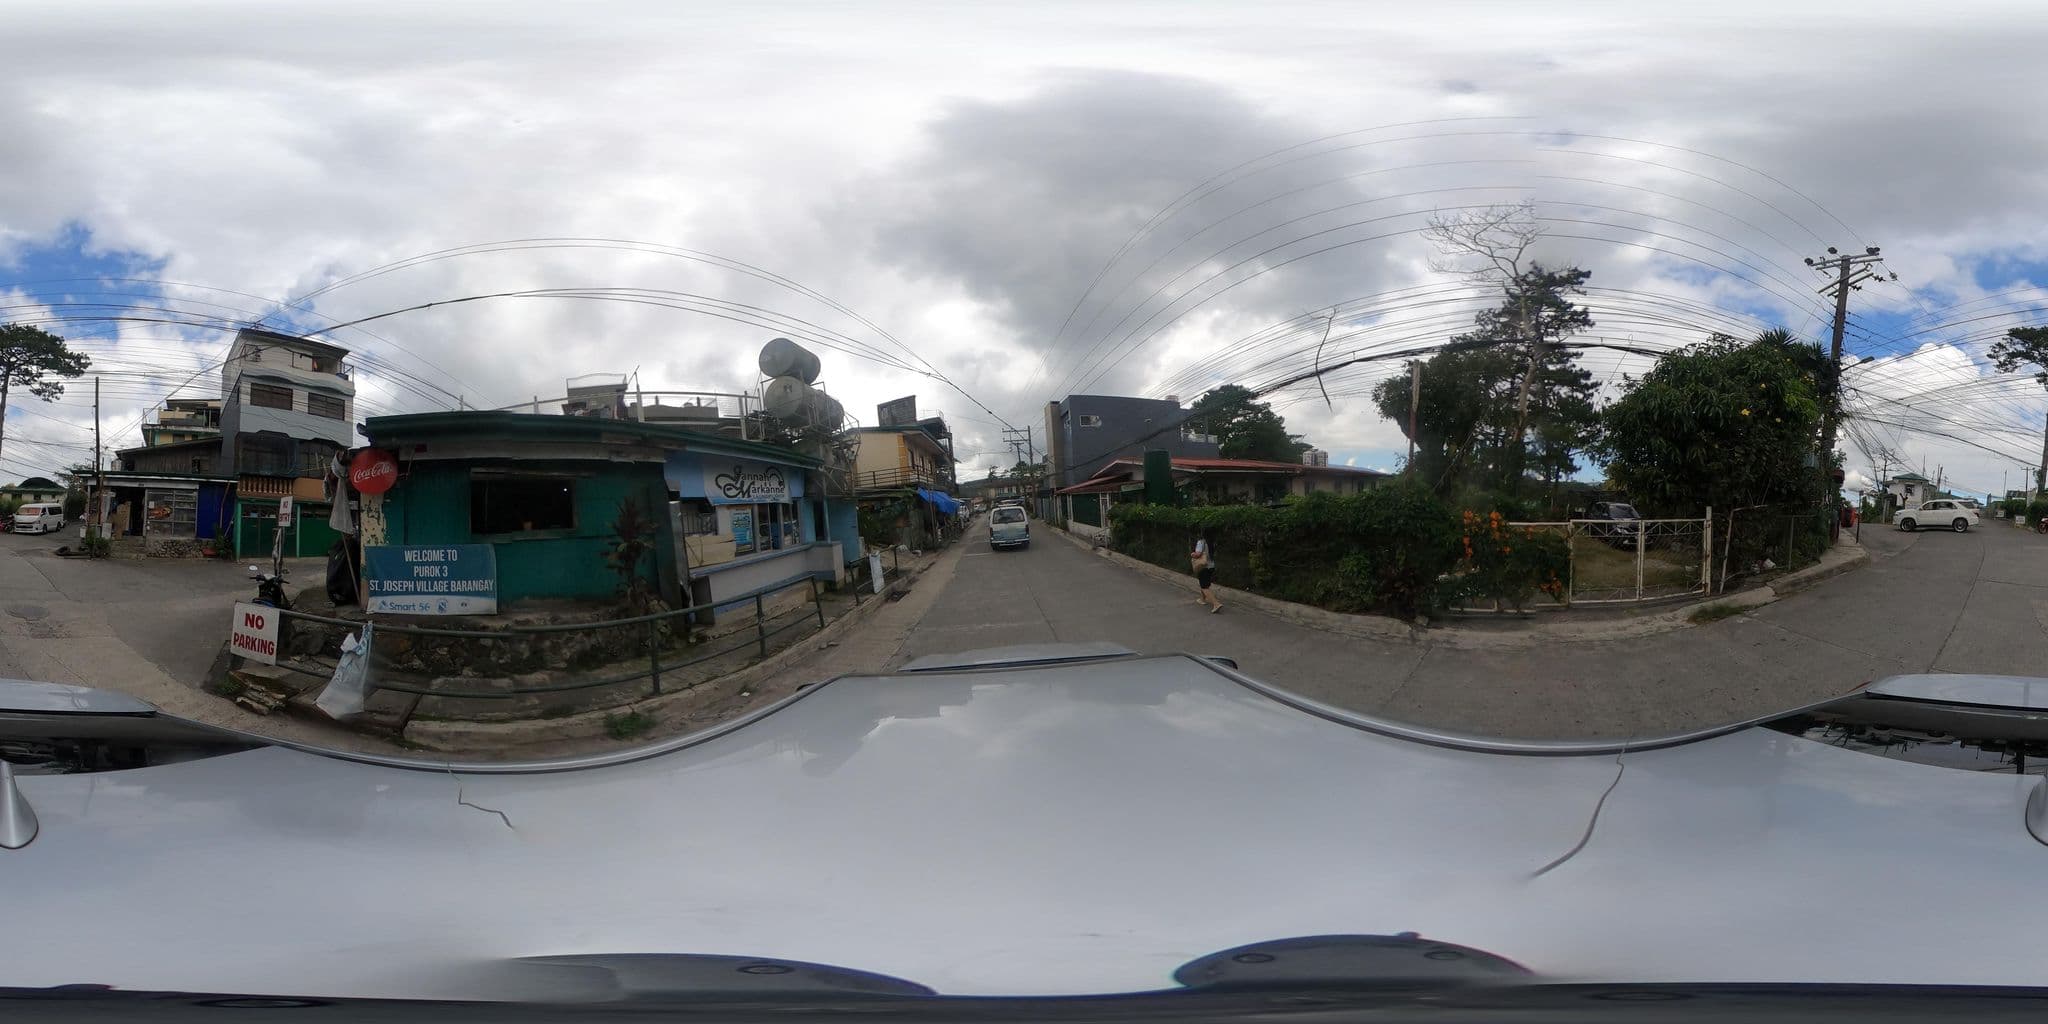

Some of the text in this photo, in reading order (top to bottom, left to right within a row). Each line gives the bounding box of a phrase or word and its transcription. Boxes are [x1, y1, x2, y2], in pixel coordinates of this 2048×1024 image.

[353, 461, 393, 483] Coca-Cola
[723, 480, 784, 498] Markanne
[404, 549, 458, 562] WELCOME TO
[413, 565, 449, 577] PUROK 3
[369, 579, 494, 592] ST. JOSEPH VILLAGE BARANGAY
[389, 602, 416, 611] Smart
[244, 612, 265, 630] NO
[233, 631, 275, 656] PARKING
